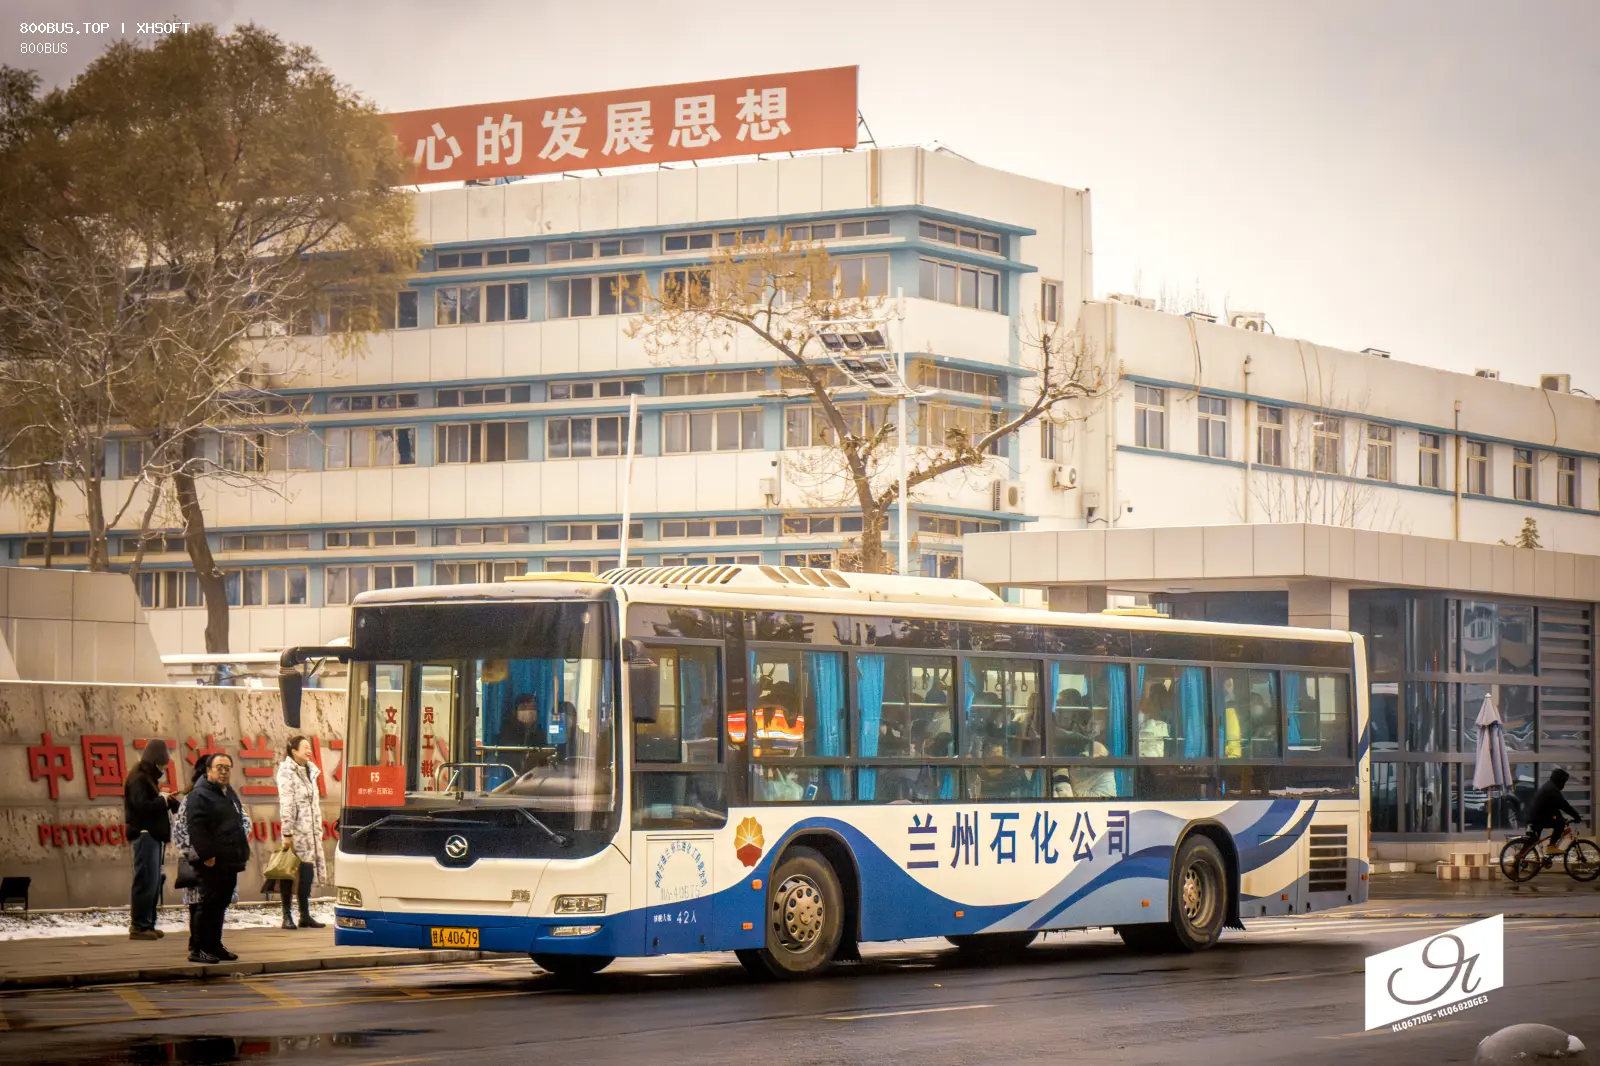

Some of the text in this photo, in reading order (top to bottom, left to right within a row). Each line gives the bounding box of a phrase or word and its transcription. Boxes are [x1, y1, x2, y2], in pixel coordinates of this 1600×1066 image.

[414, 87, 791, 171] 心的发展思想
[907, 810, 1130, 869] 兰州石化公司
